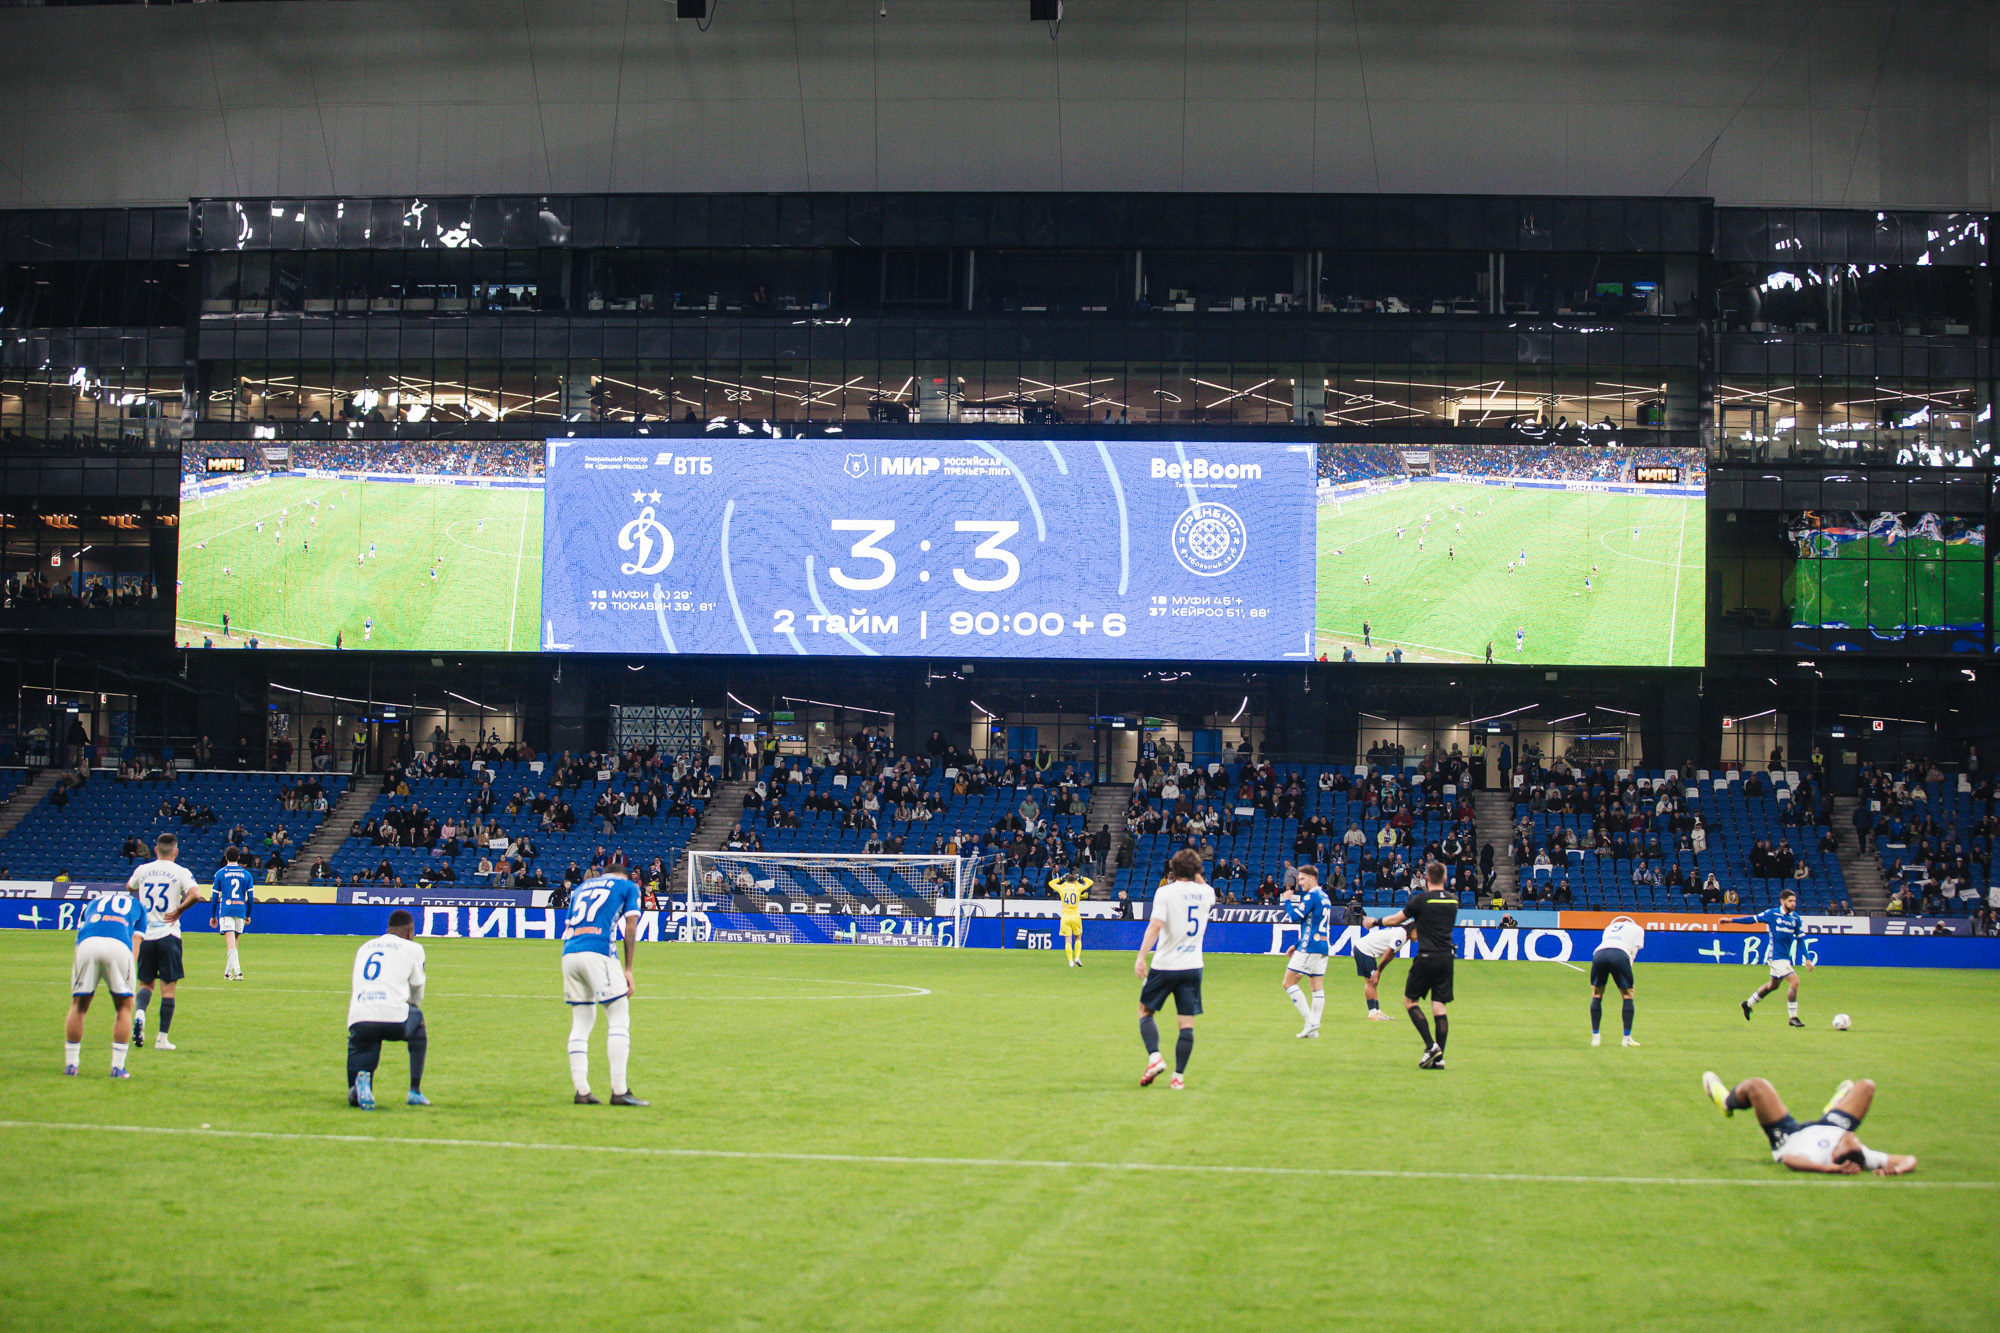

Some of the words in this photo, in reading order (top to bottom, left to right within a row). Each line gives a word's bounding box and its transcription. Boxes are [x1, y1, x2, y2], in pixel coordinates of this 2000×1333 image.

[624, 456, 648, 464] спонсор
[674, 456, 713, 475] ВТБ
[881, 457, 941, 475] МИР
[944, 456, 1003, 466] РОССИЙСКАЯ
[1151, 458, 1262, 480] BetBoom
[944, 467, 1011, 476] ПРЕМЬЕР-ЛИГА
[1637, 468, 1677, 482] МАТЧ!
[1179, 507, 1241, 536] ОРЕНБУРГ
[828, 519, 897, 591] 3
[952, 520, 1021, 592] 3
[591, 590, 607, 599] 18
[611, 591, 649, 599] МУФИ
[1151, 596, 1168, 605] 18
[1171, 597, 1211, 605] МУФИ
[588, 602, 607, 611] 70
[610, 602, 672, 611] ТЮКАВИН
[1149, 608, 1168, 617] 37
[1171, 606, 1225, 617] КЕЙРОС
[772, 610, 795, 633] 2
[805, 608, 899, 635] тайм
[949, 612, 1065, 637] 90:00
[1102, 613, 1128, 638] 6
[143, 882, 170, 913] 33
[230, 878, 240, 899] 2
[96, 894, 132, 916] 70
[570, 888, 611, 926] 57
[1063, 893, 1077, 905] 40
[1187, 906, 1199, 937] 5
[1208, 908, 1293, 923] АЛТИКА
[728, 932, 743, 942] ВТБ
[752, 933, 767, 943] ВТБ
[776, 934, 791, 944] ВТБ
[868, 935, 884, 945] ВТБ
[893, 936, 908, 946] ВТБ
[917, 938, 932, 947] ВТБ
[1027, 932, 1053, 950] ВТБ
[363, 952, 385, 981] 6
